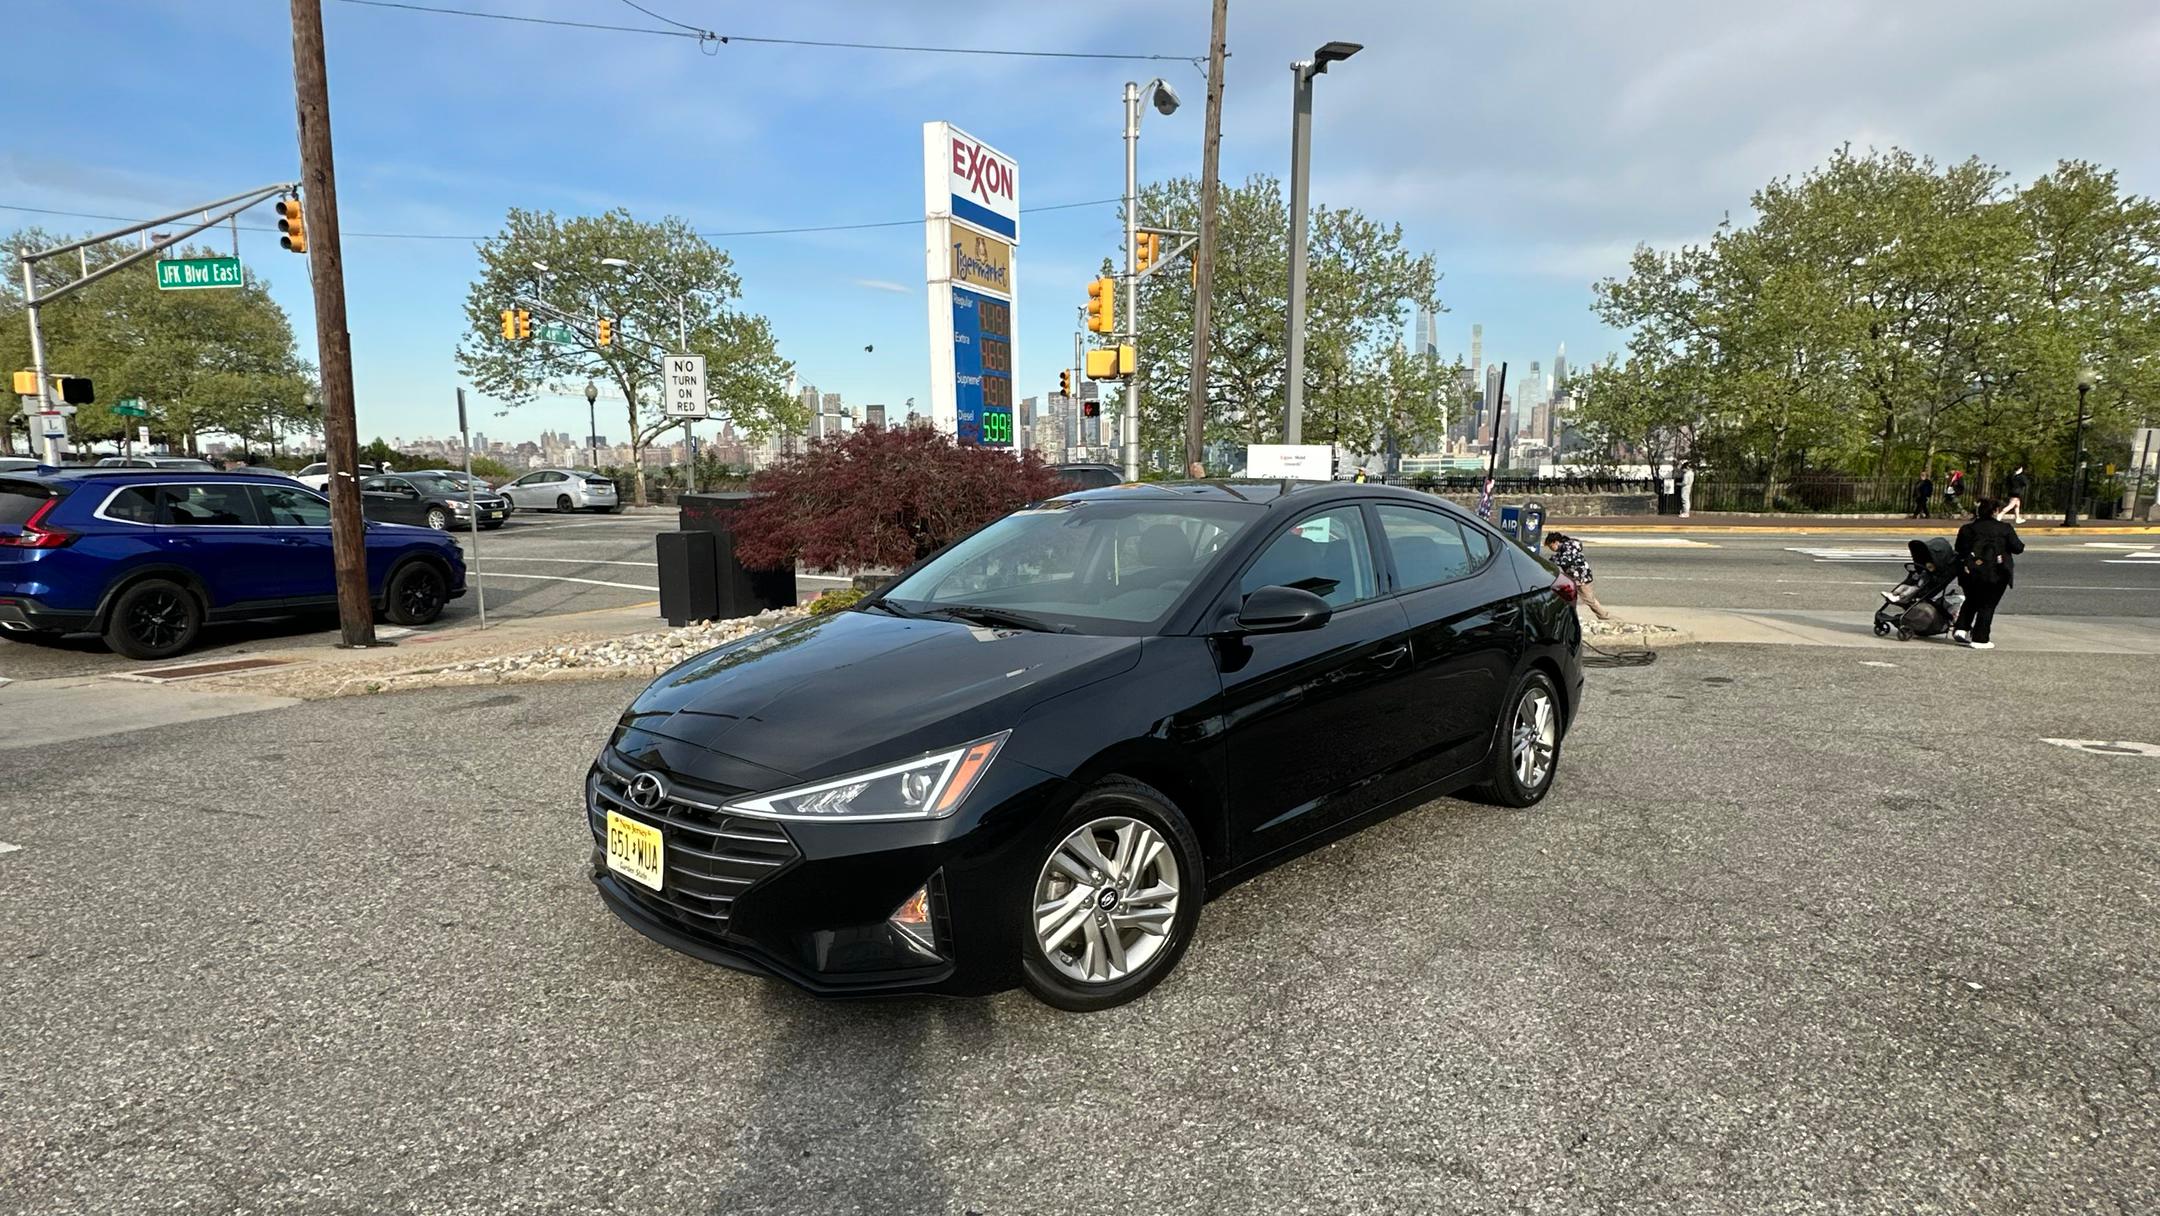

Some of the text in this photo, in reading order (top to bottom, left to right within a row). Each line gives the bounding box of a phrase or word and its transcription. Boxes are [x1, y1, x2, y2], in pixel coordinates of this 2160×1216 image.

[952, 137, 1013, 205] EXXON
[953, 242, 1008, 288] Tigermarket
[162, 263, 239, 284] JFK Blvd East
[953, 292, 974, 310] Regular
[954, 331, 970, 345] Extra
[674, 360, 694, 373] NO
[672, 375, 697, 386] TURN
[678, 388, 693, 398] ON
[677, 401, 696, 412] RED
[958, 409, 975, 422] Diesel
[1502, 519, 1518, 531] AIR
